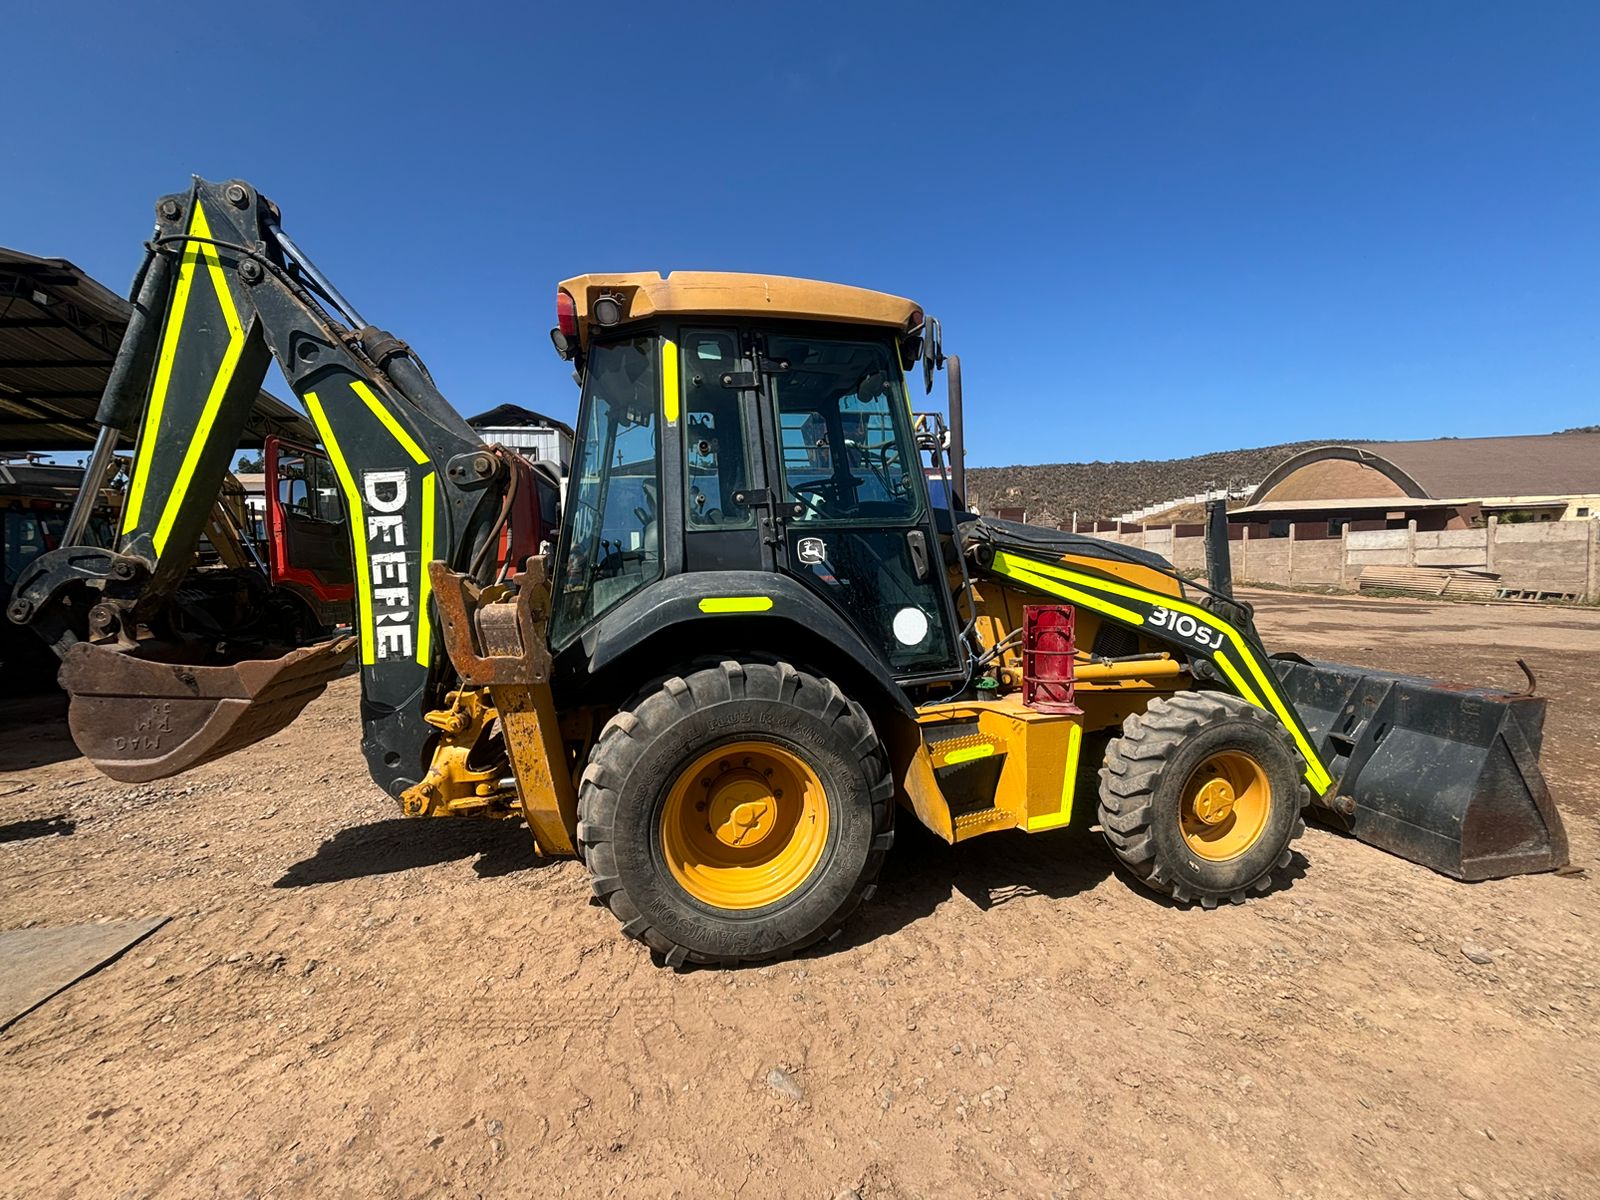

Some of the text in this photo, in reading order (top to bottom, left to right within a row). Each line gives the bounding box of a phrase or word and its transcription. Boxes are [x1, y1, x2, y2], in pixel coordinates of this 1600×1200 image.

[364, 471, 412, 659] DEERE
[1148, 604, 1224, 649] 310SJ
[708, 711, 752, 731] PLUS
[648, 895, 752, 948] SAMSON
